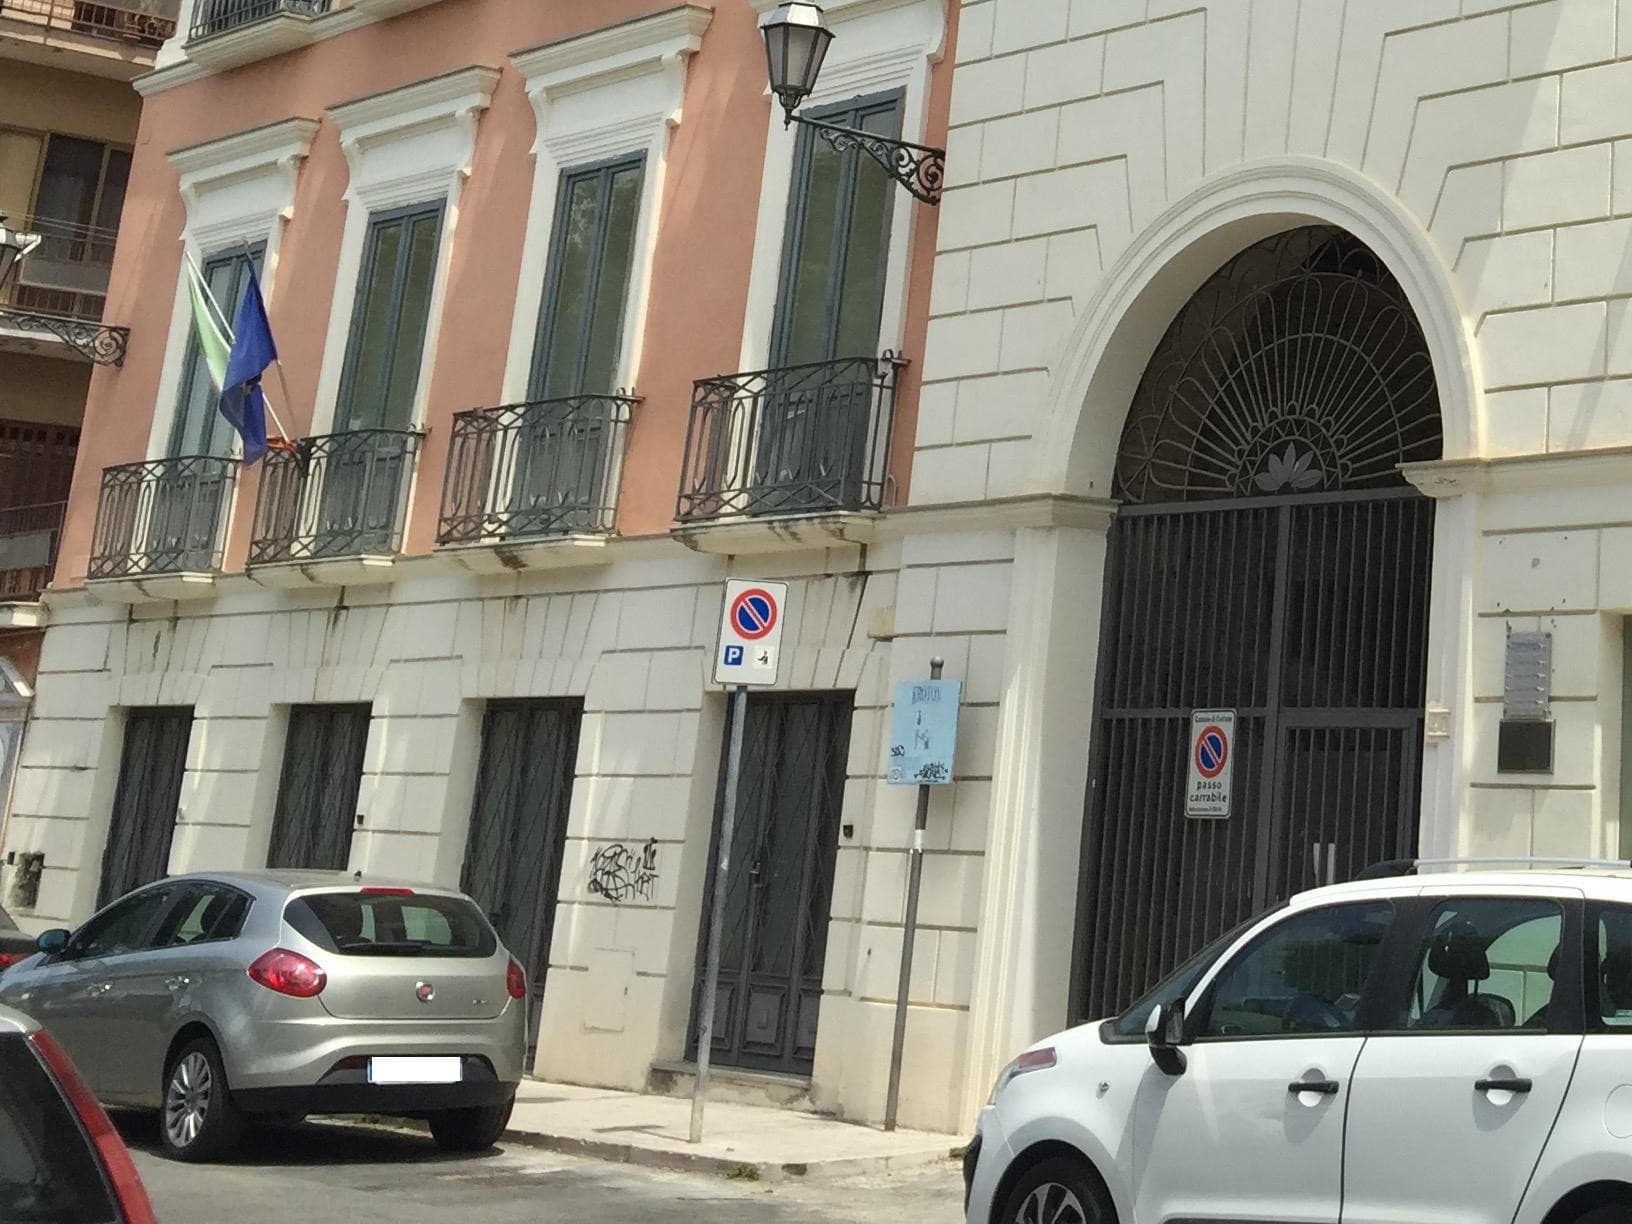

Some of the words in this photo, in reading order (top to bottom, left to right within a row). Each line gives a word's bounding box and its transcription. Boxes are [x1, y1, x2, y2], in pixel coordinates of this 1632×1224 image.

[728, 648, 740, 662] P
[1197, 781, 1222, 791] passo
[1189, 792, 1227, 802] carrabile
